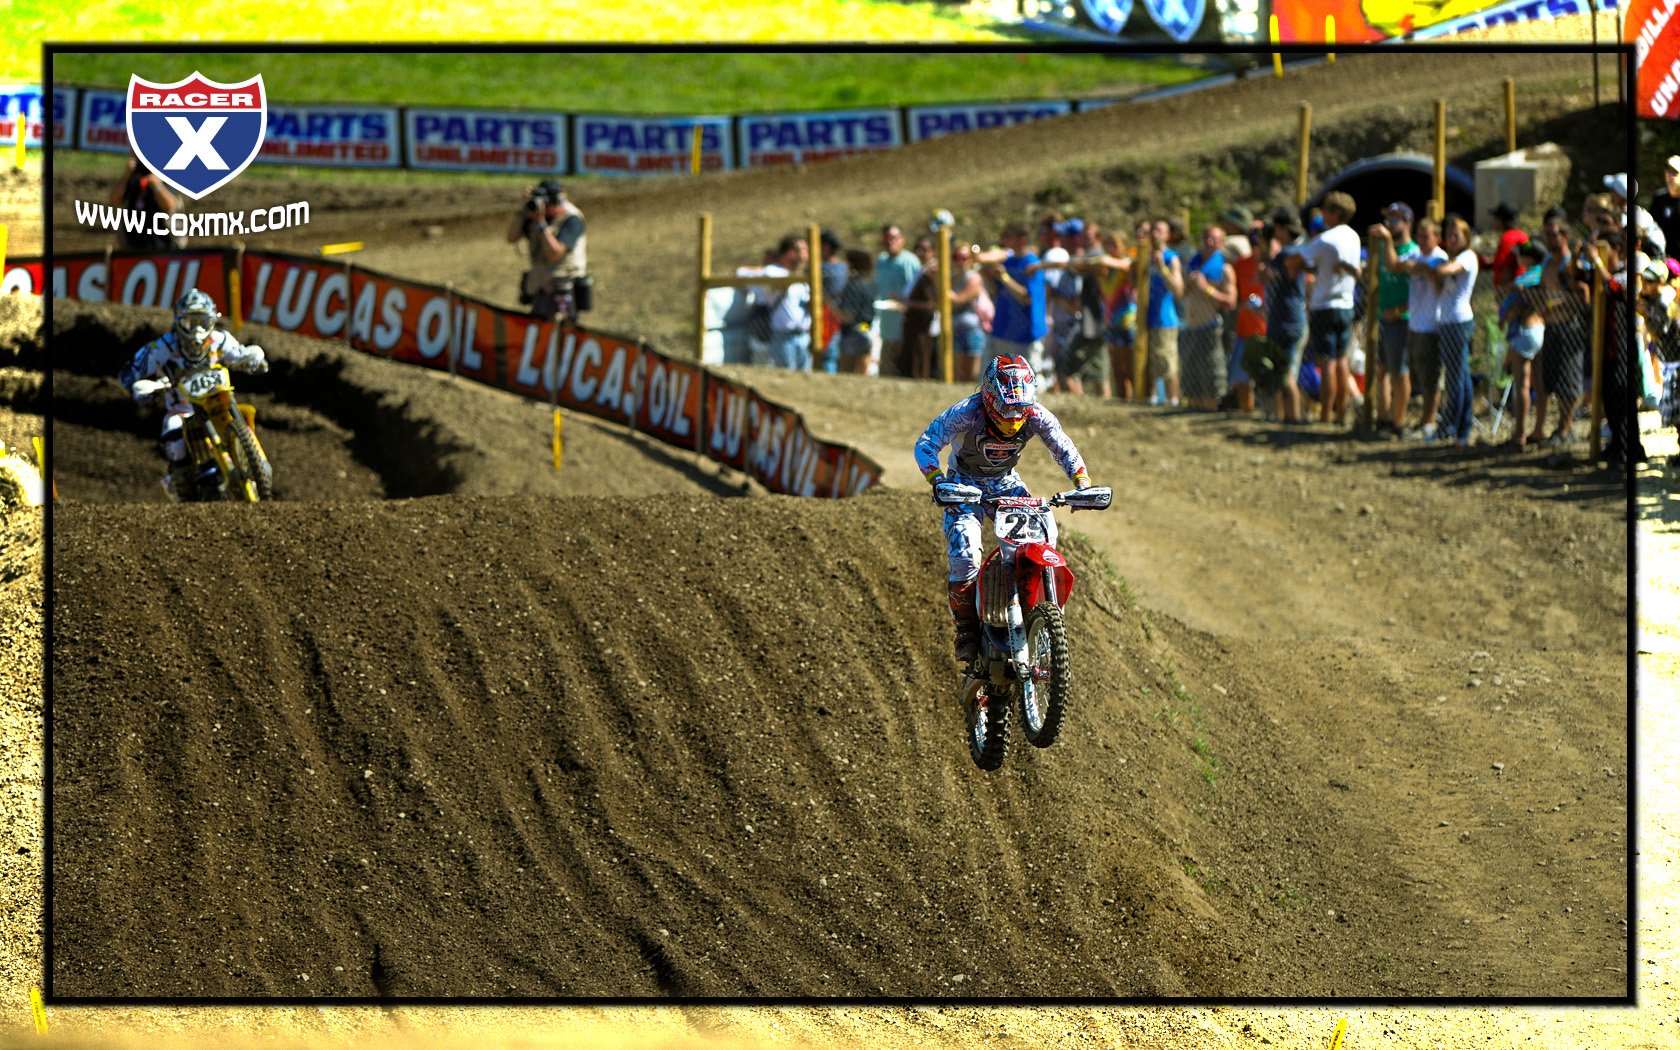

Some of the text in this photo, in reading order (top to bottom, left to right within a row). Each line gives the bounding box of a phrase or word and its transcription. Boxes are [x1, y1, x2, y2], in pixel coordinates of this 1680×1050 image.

[267, 112, 386, 139] ARTS
[415, 115, 556, 146] PARTS
[584, 122, 719, 150] PARTS
[749, 116, 891, 149] PARTS
[415, 143, 558, 168] UNLIMITED
[251, 262, 482, 371] LUCAS OIL
[516, 323, 691, 437] LUCAS OIL
